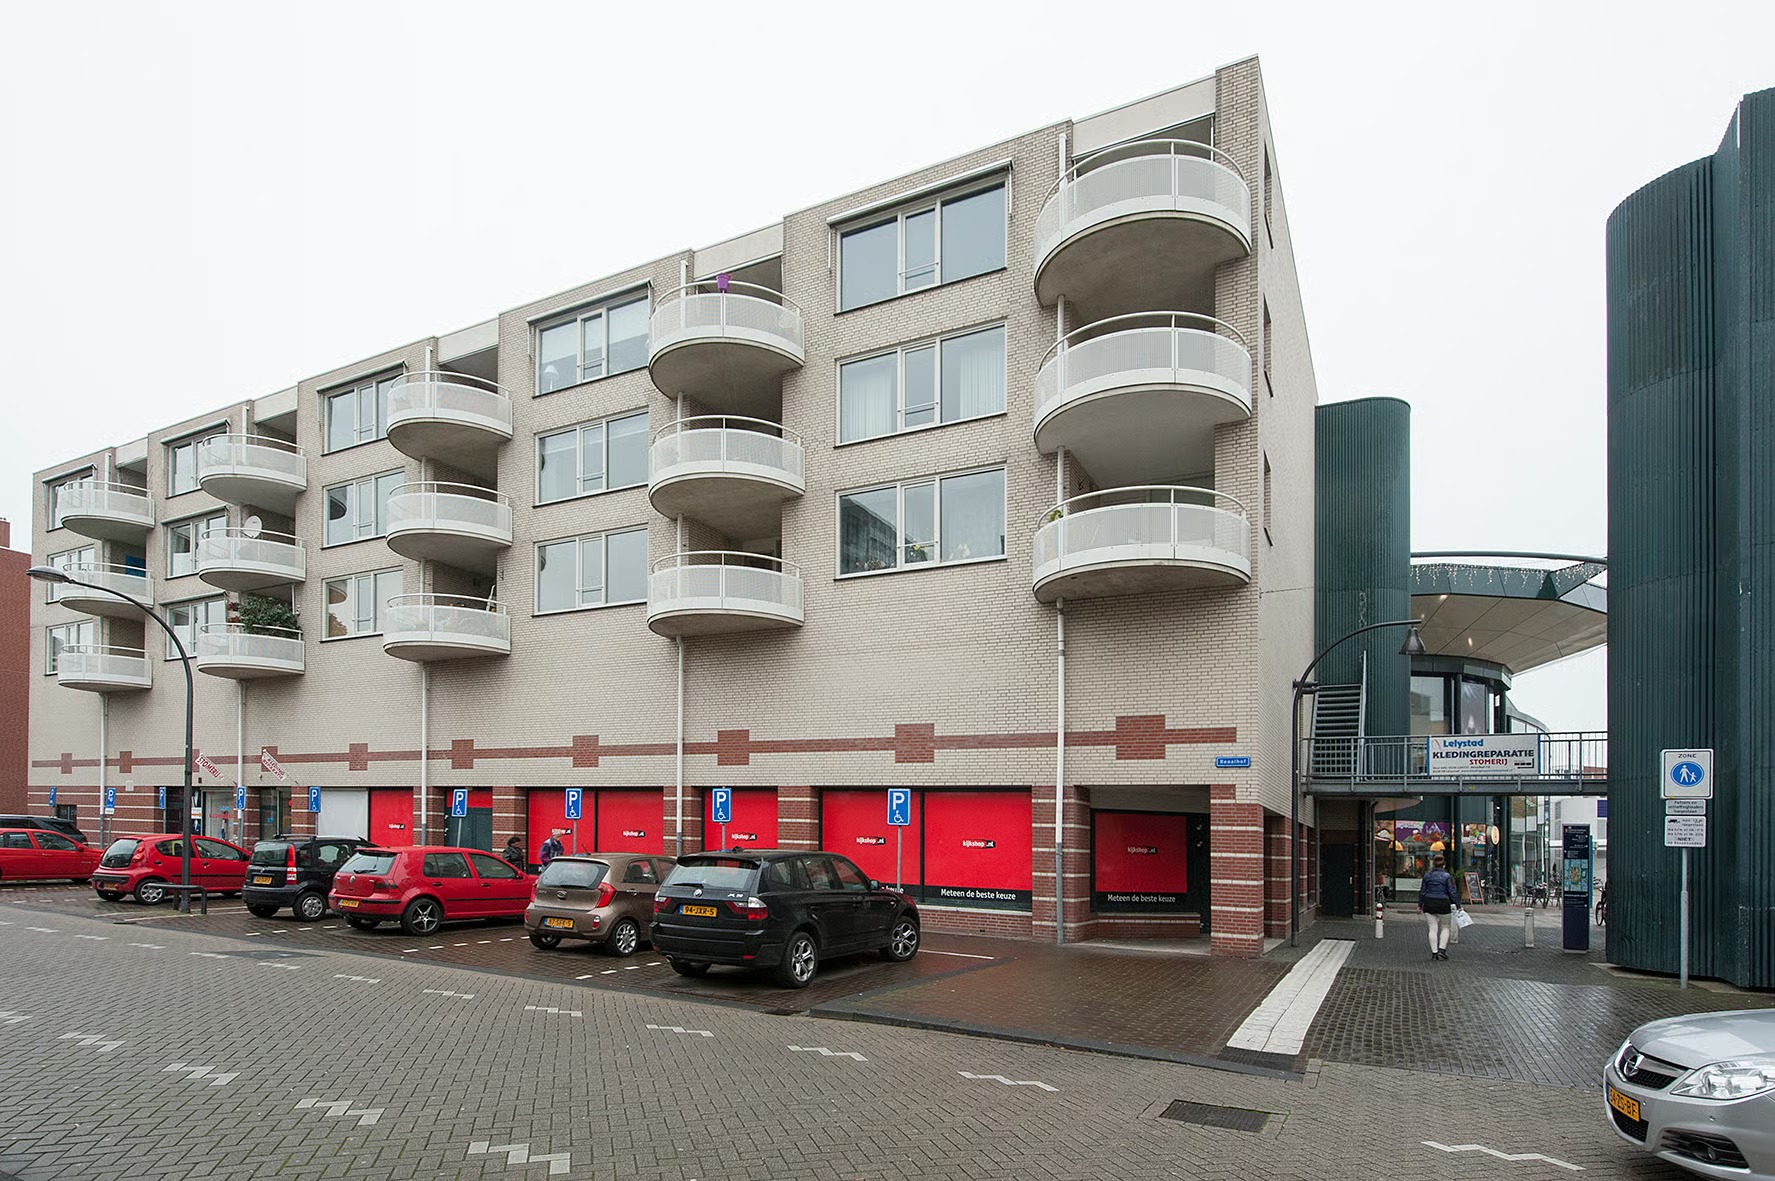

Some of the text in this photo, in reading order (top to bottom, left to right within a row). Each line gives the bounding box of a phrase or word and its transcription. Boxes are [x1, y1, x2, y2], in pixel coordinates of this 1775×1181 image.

[1443, 739, 1484, 748] Lelystad
[1432, 749, 1535, 759] KLEDINGREPARATIE
[1469, 758, 1508, 766] STOMERIJ
[312, 788, 318, 802] P
[455, 792, 464, 806] P
[568, 792, 578, 806] P
[716, 792, 726, 808] P
[892, 792, 905, 810] P
[940, 888, 1016, 900] Meteen de beste keuze
[1108, 894, 1176, 903] Meteen de beste keuze
